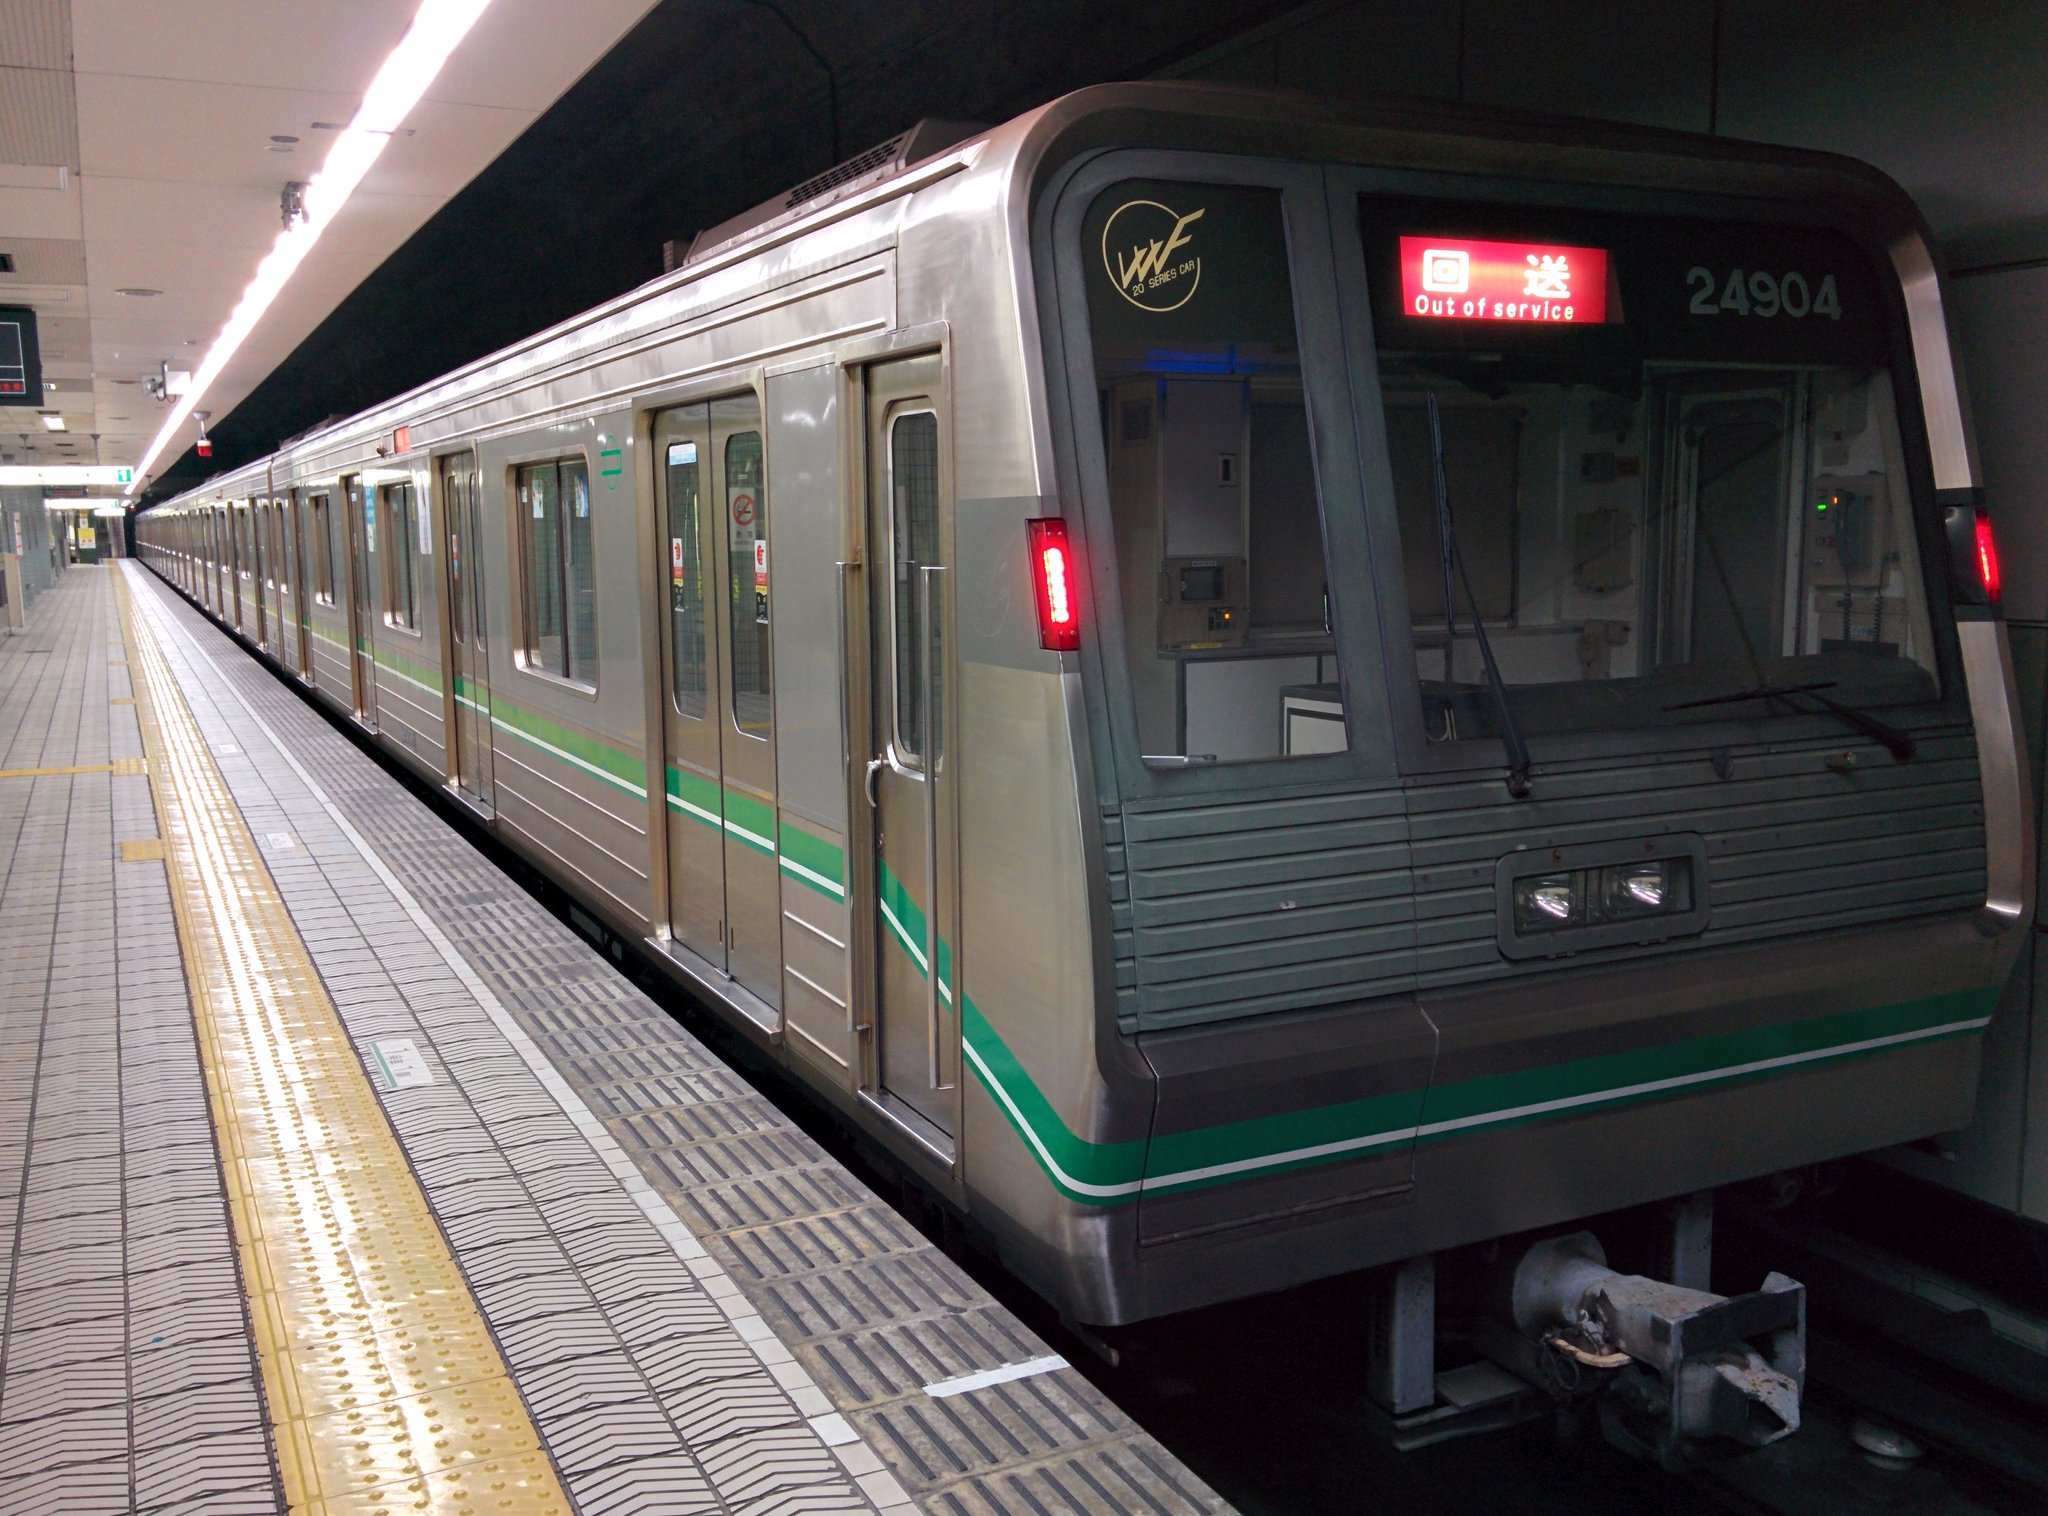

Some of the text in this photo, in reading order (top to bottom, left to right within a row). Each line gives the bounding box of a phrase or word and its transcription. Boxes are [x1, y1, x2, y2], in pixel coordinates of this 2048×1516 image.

[1132, 260, 1195, 297] 20 SERIES CAR
[1422, 248, 1571, 299] 回送
[1686, 266, 1842, 320] 24904
[1415, 294, 1574, 321] Out of service
